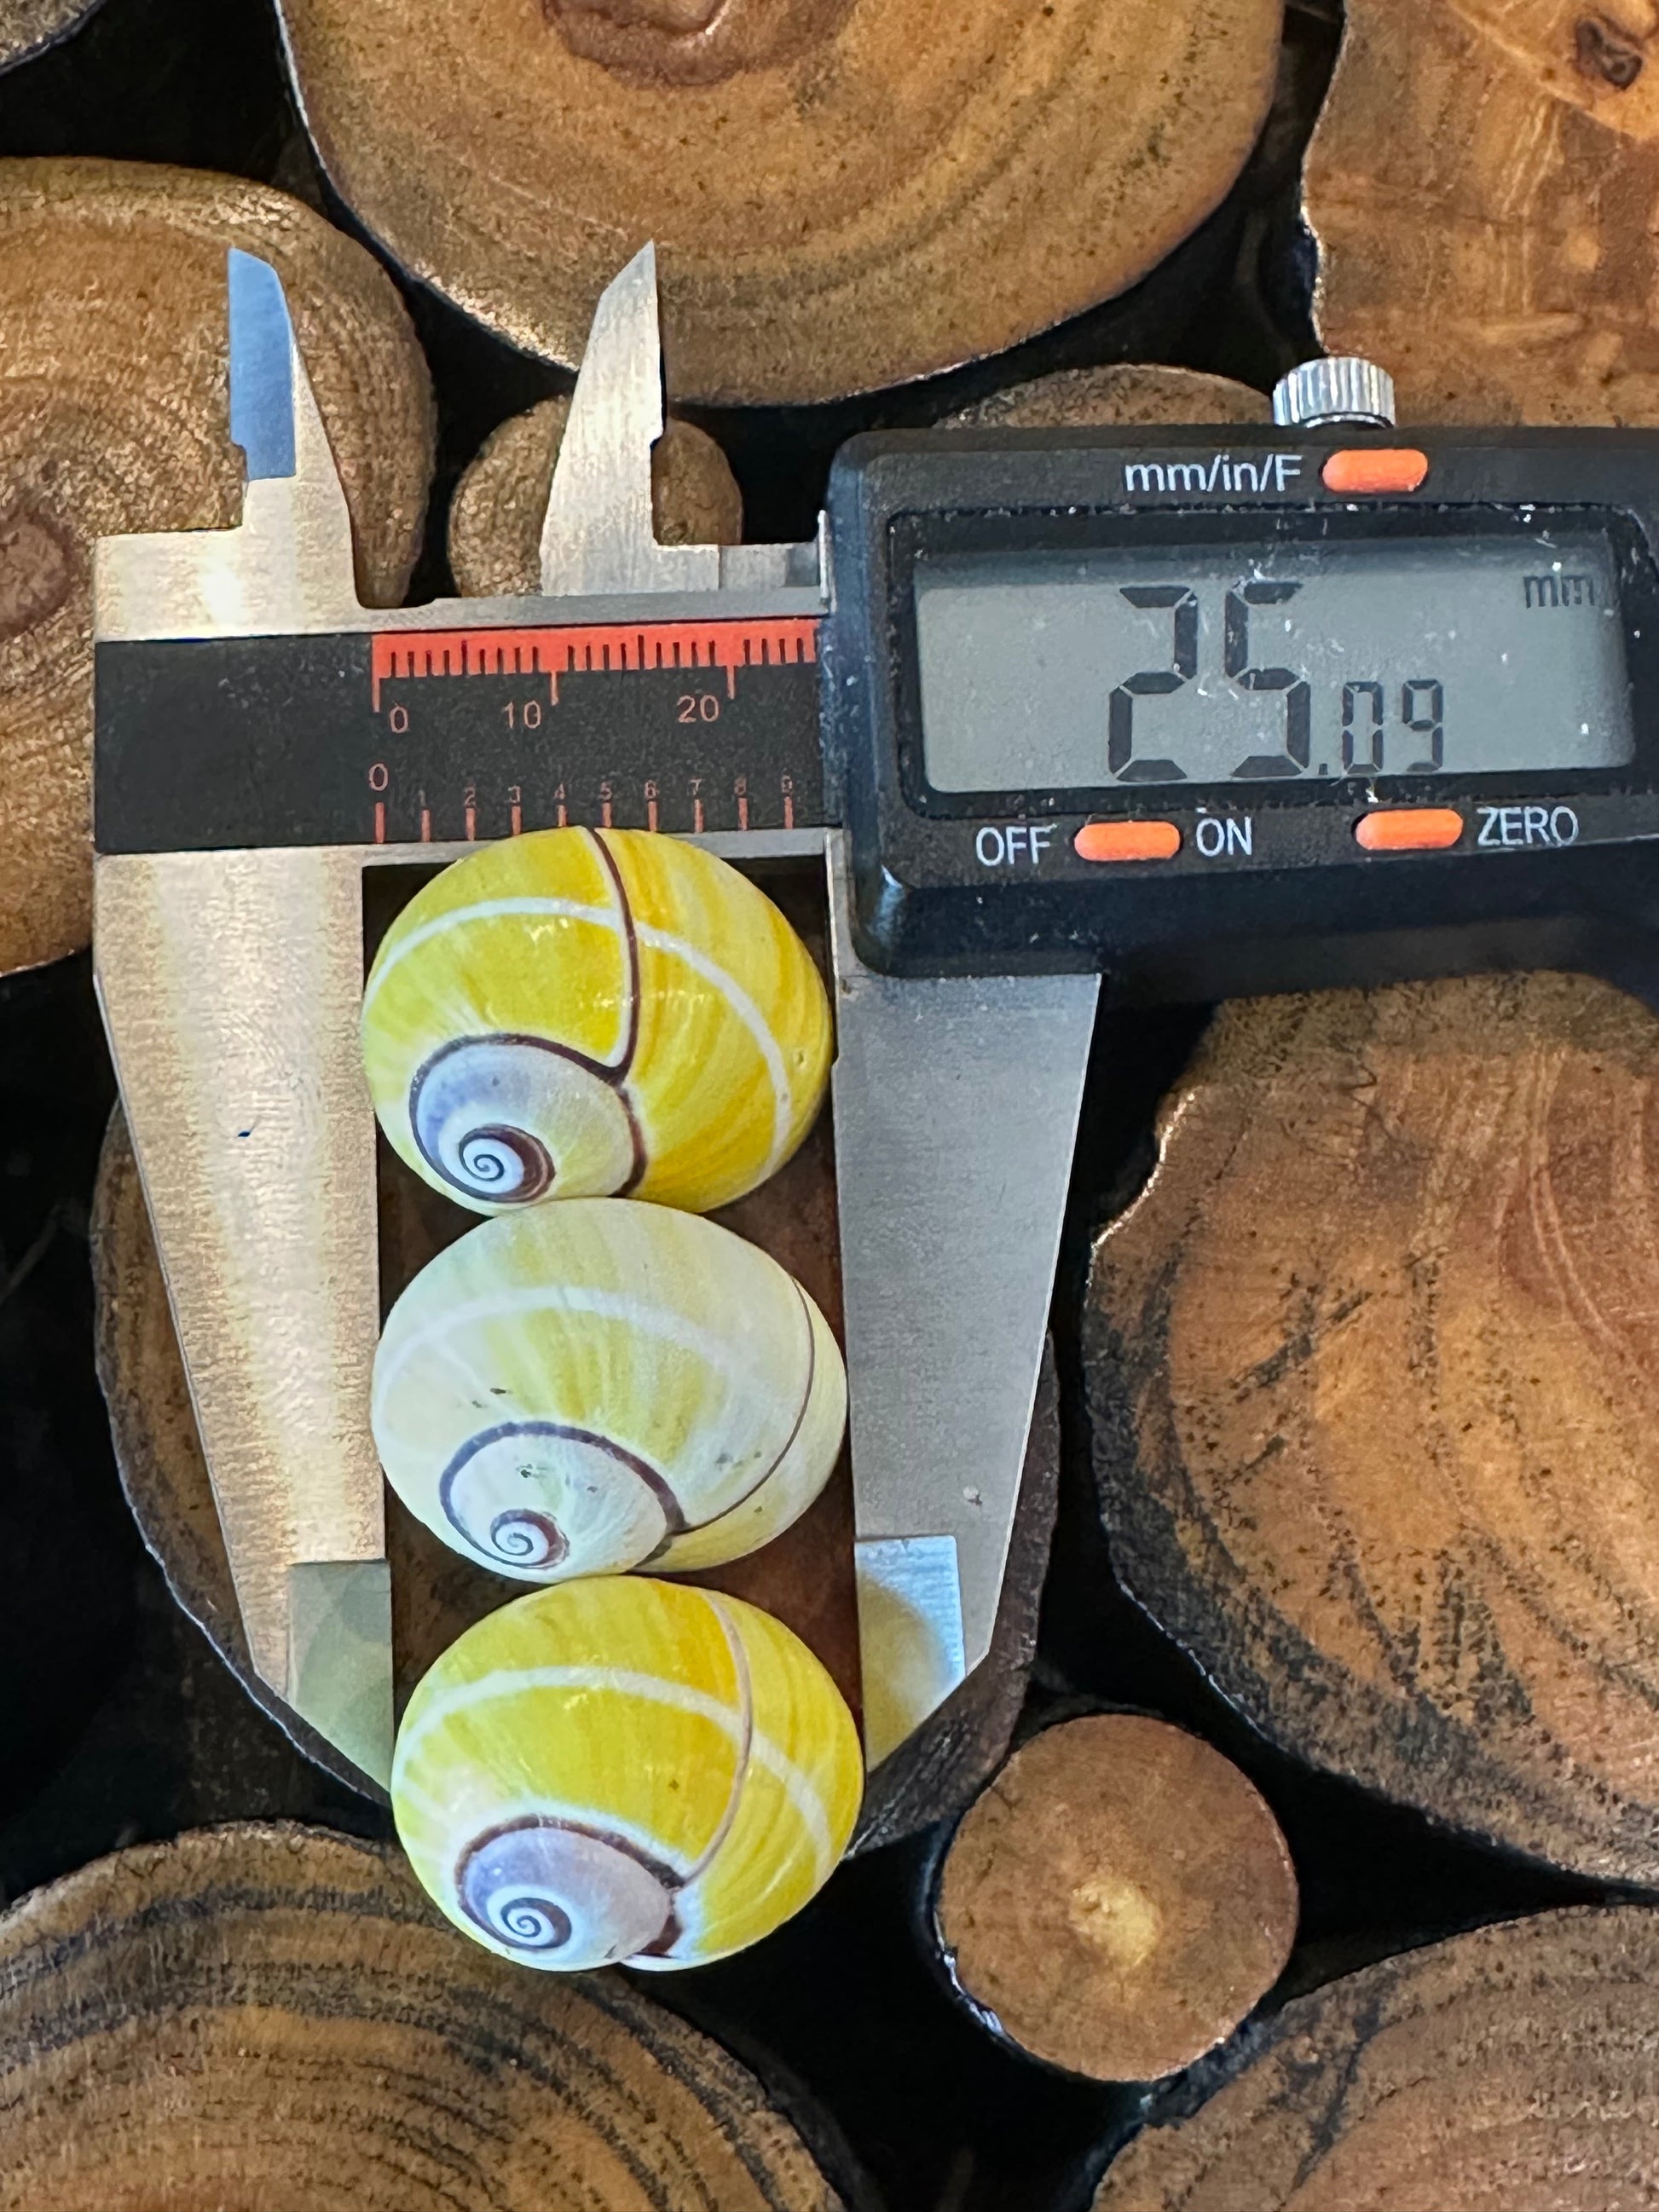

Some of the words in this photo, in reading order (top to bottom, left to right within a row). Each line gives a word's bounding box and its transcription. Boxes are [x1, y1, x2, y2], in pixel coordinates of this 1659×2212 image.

[1124, 453, 1303, 494] mm/in/F
[1523, 573, 1594, 609] mm
[1107, 581, 1444, 783] 25.09
[389, 706, 409, 733] 0
[503, 700, 541, 730] 10
[677, 695, 720, 724] 20
[368, 764, 389, 791] 0
[463, 787, 476, 806] 2
[509, 785, 521, 804] 3
[555, 783, 565, 800] 4
[600, 781, 612, 800] 5
[645, 780, 658, 798] 6
[691, 778, 702, 794] 7
[975, 826, 1052, 866] OFF
[1196, 817, 1253, 857] ON
[1477, 806, 1579, 847] ZERO
